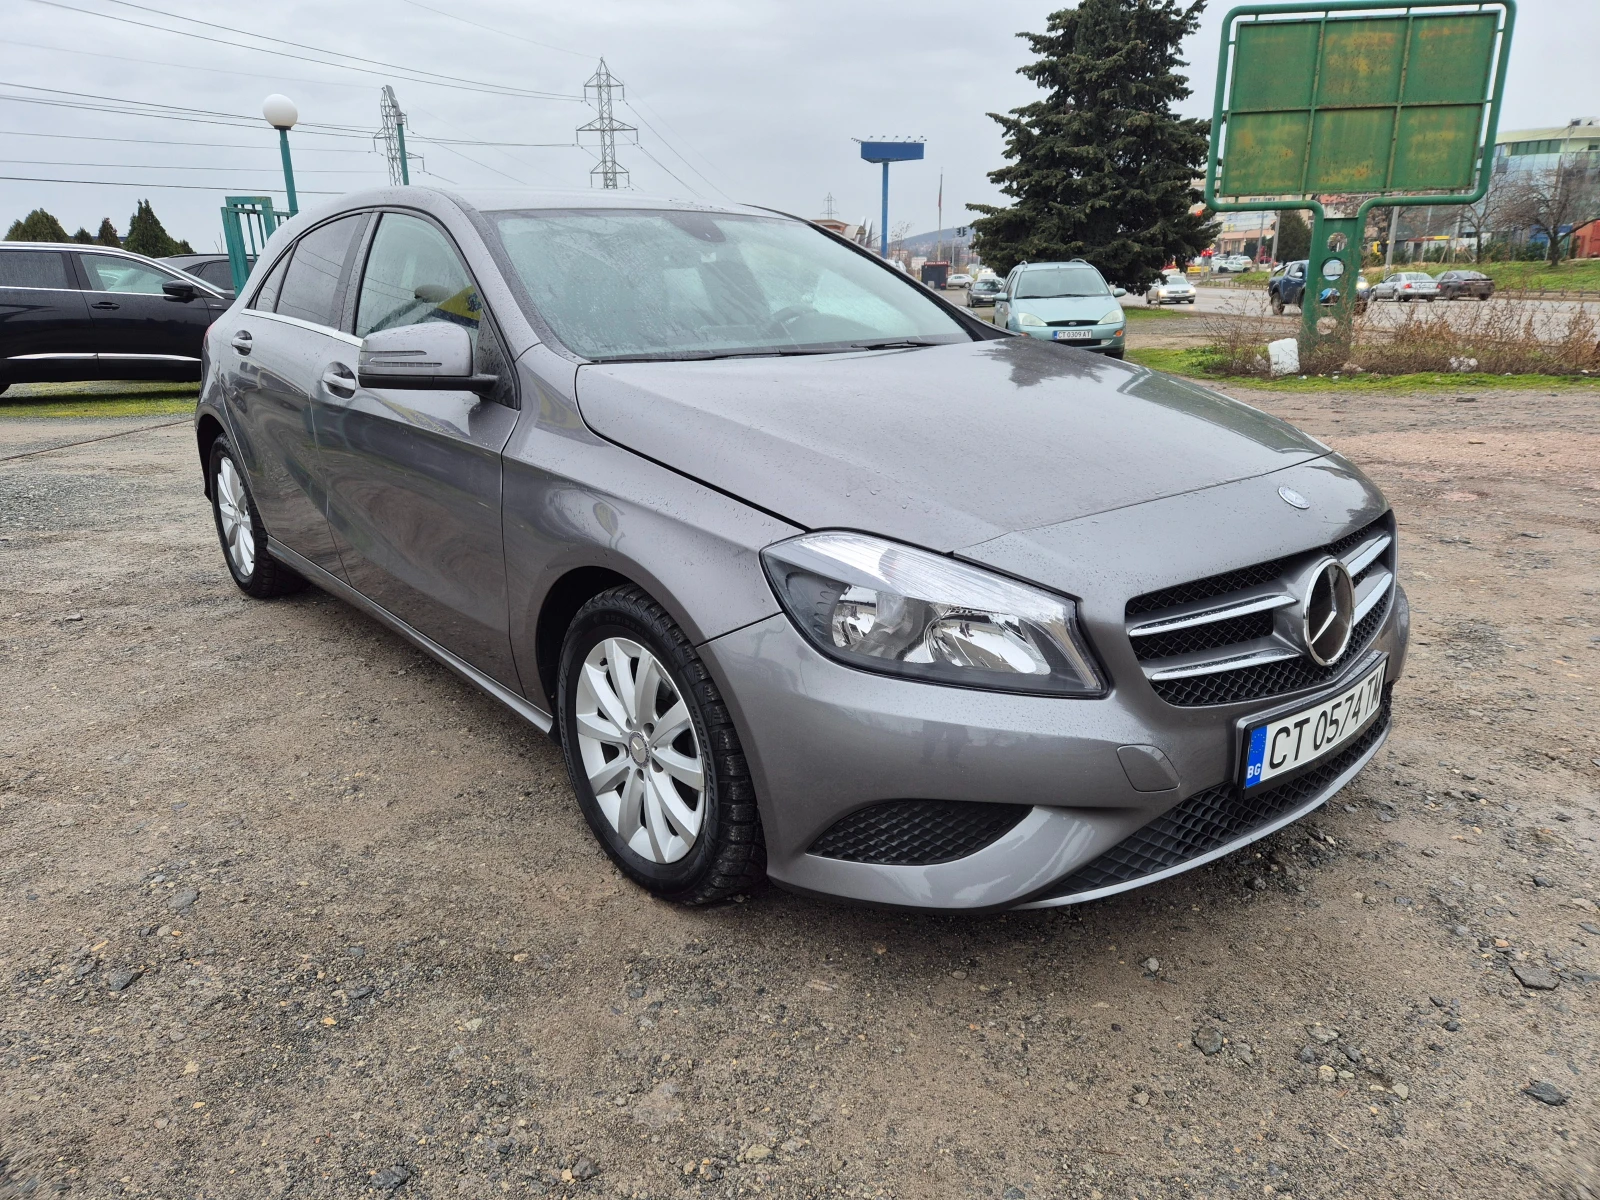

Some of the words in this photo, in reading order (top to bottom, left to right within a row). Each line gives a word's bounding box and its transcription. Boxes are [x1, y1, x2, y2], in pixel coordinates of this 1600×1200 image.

[1268, 717, 1311, 770] CT
[1313, 685, 1364, 751] 0574
[1246, 763, 1261, 779] BG
